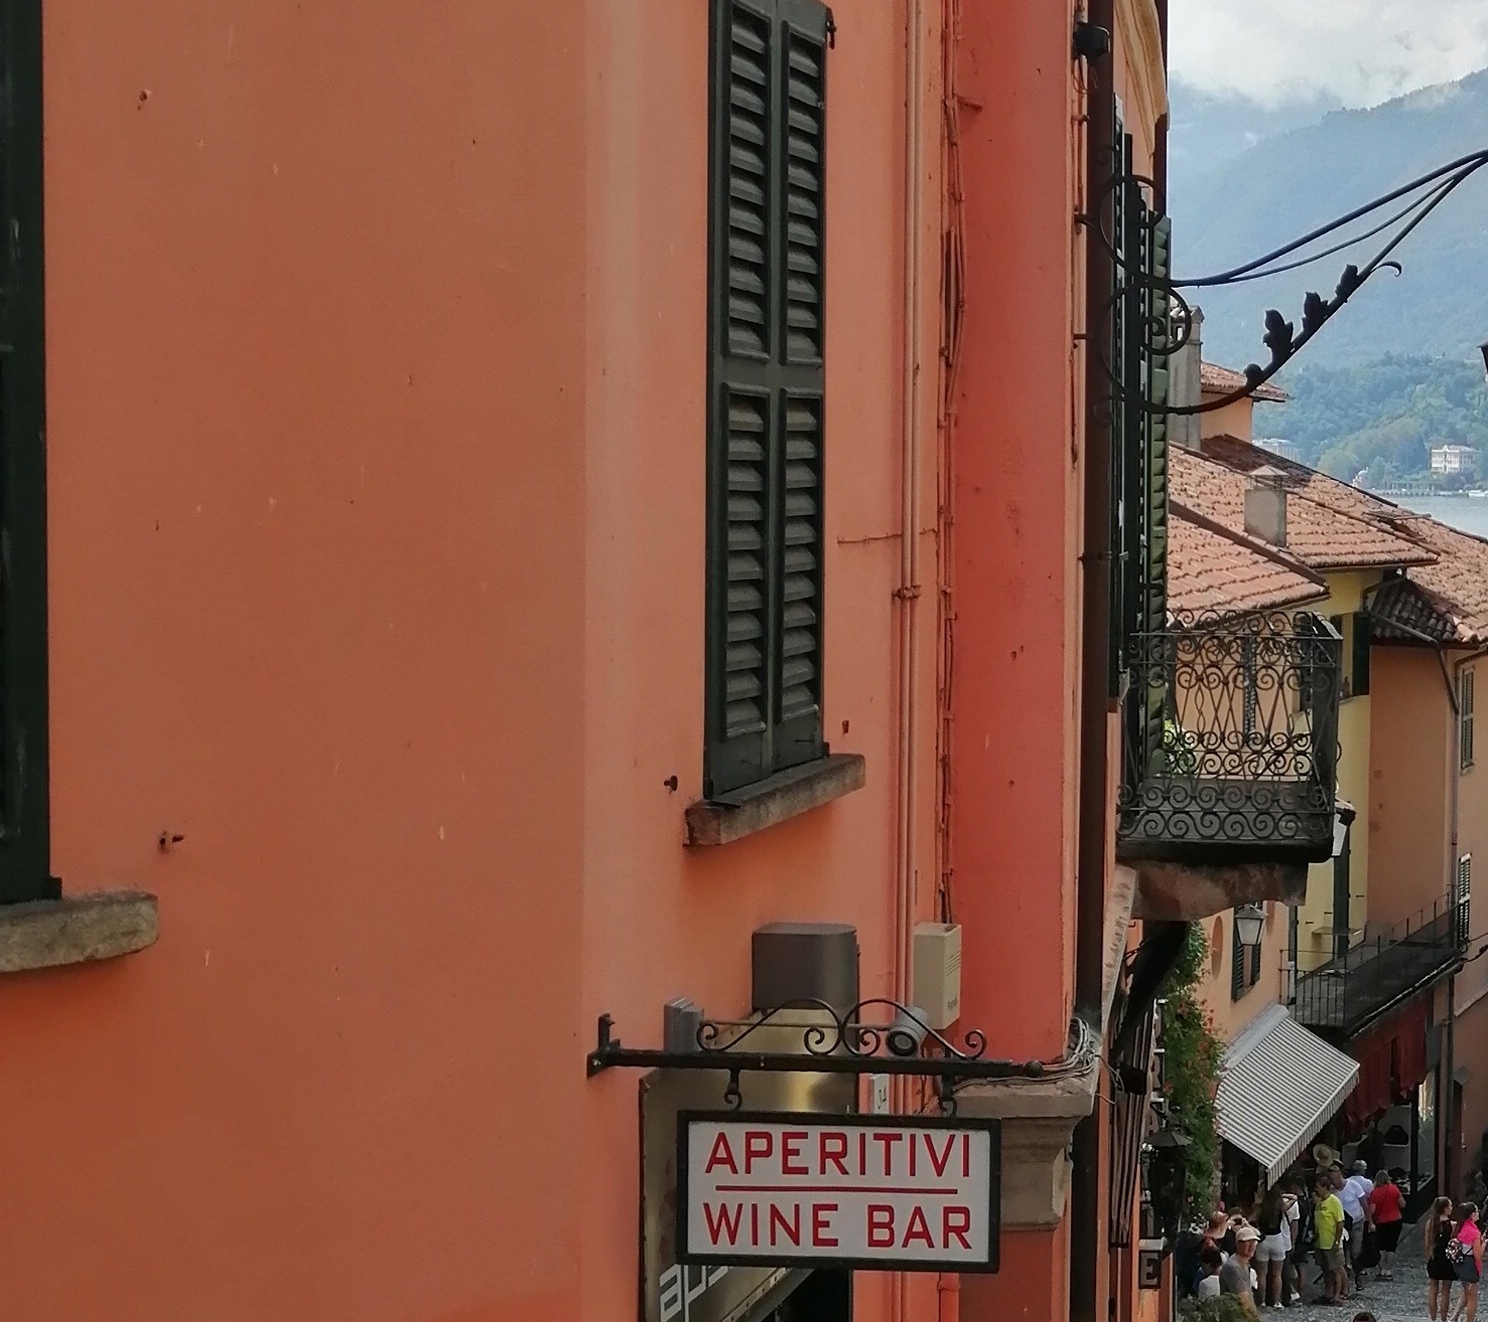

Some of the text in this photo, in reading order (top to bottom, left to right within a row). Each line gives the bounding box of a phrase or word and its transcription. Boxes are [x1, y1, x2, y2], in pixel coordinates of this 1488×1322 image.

[704, 1131, 970, 1178] APERITIVI
[702, 1202, 973, 1250] WINE BAR
